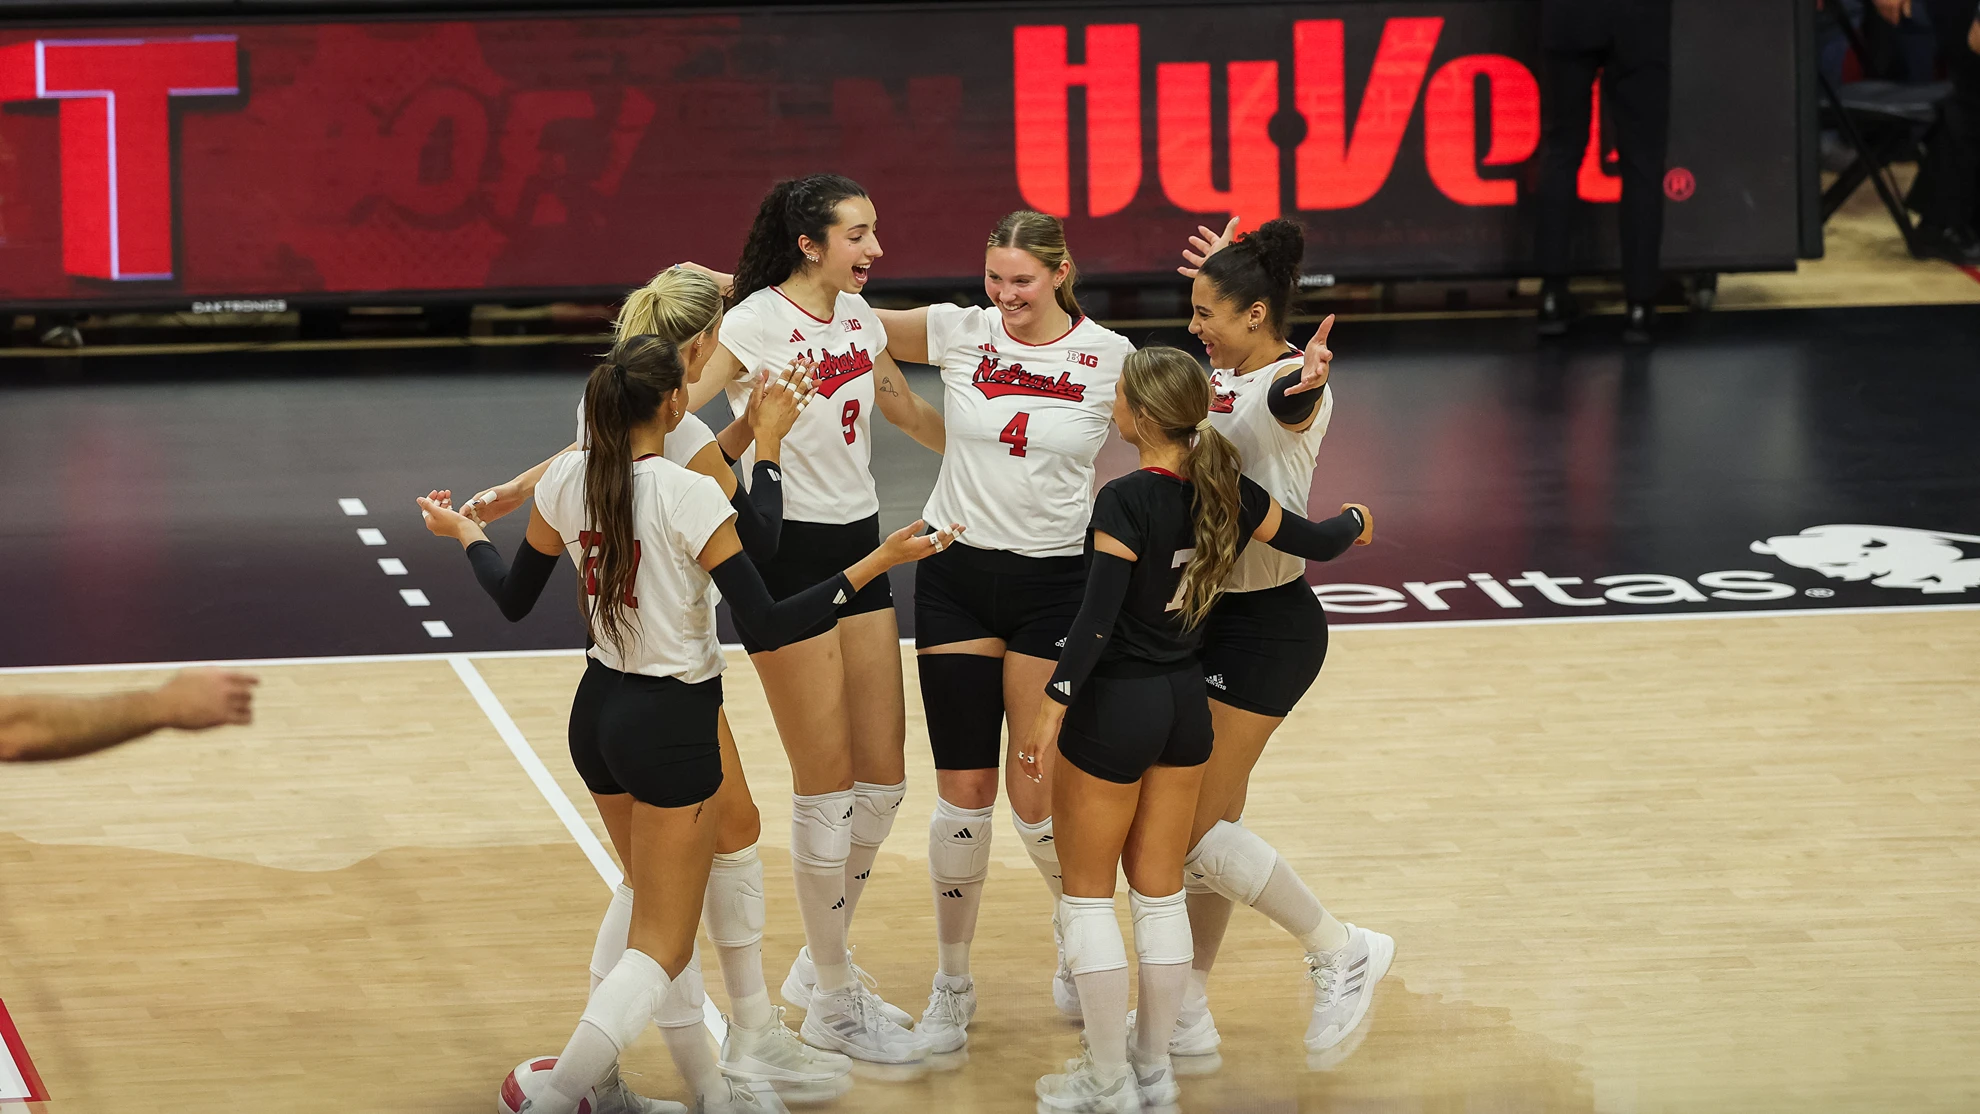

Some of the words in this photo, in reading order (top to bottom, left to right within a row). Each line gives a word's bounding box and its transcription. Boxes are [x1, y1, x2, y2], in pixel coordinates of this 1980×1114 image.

[972, 355, 1086, 398] Nebraska
[841, 399, 861, 445] 9
[999, 411, 1030, 458] 4
